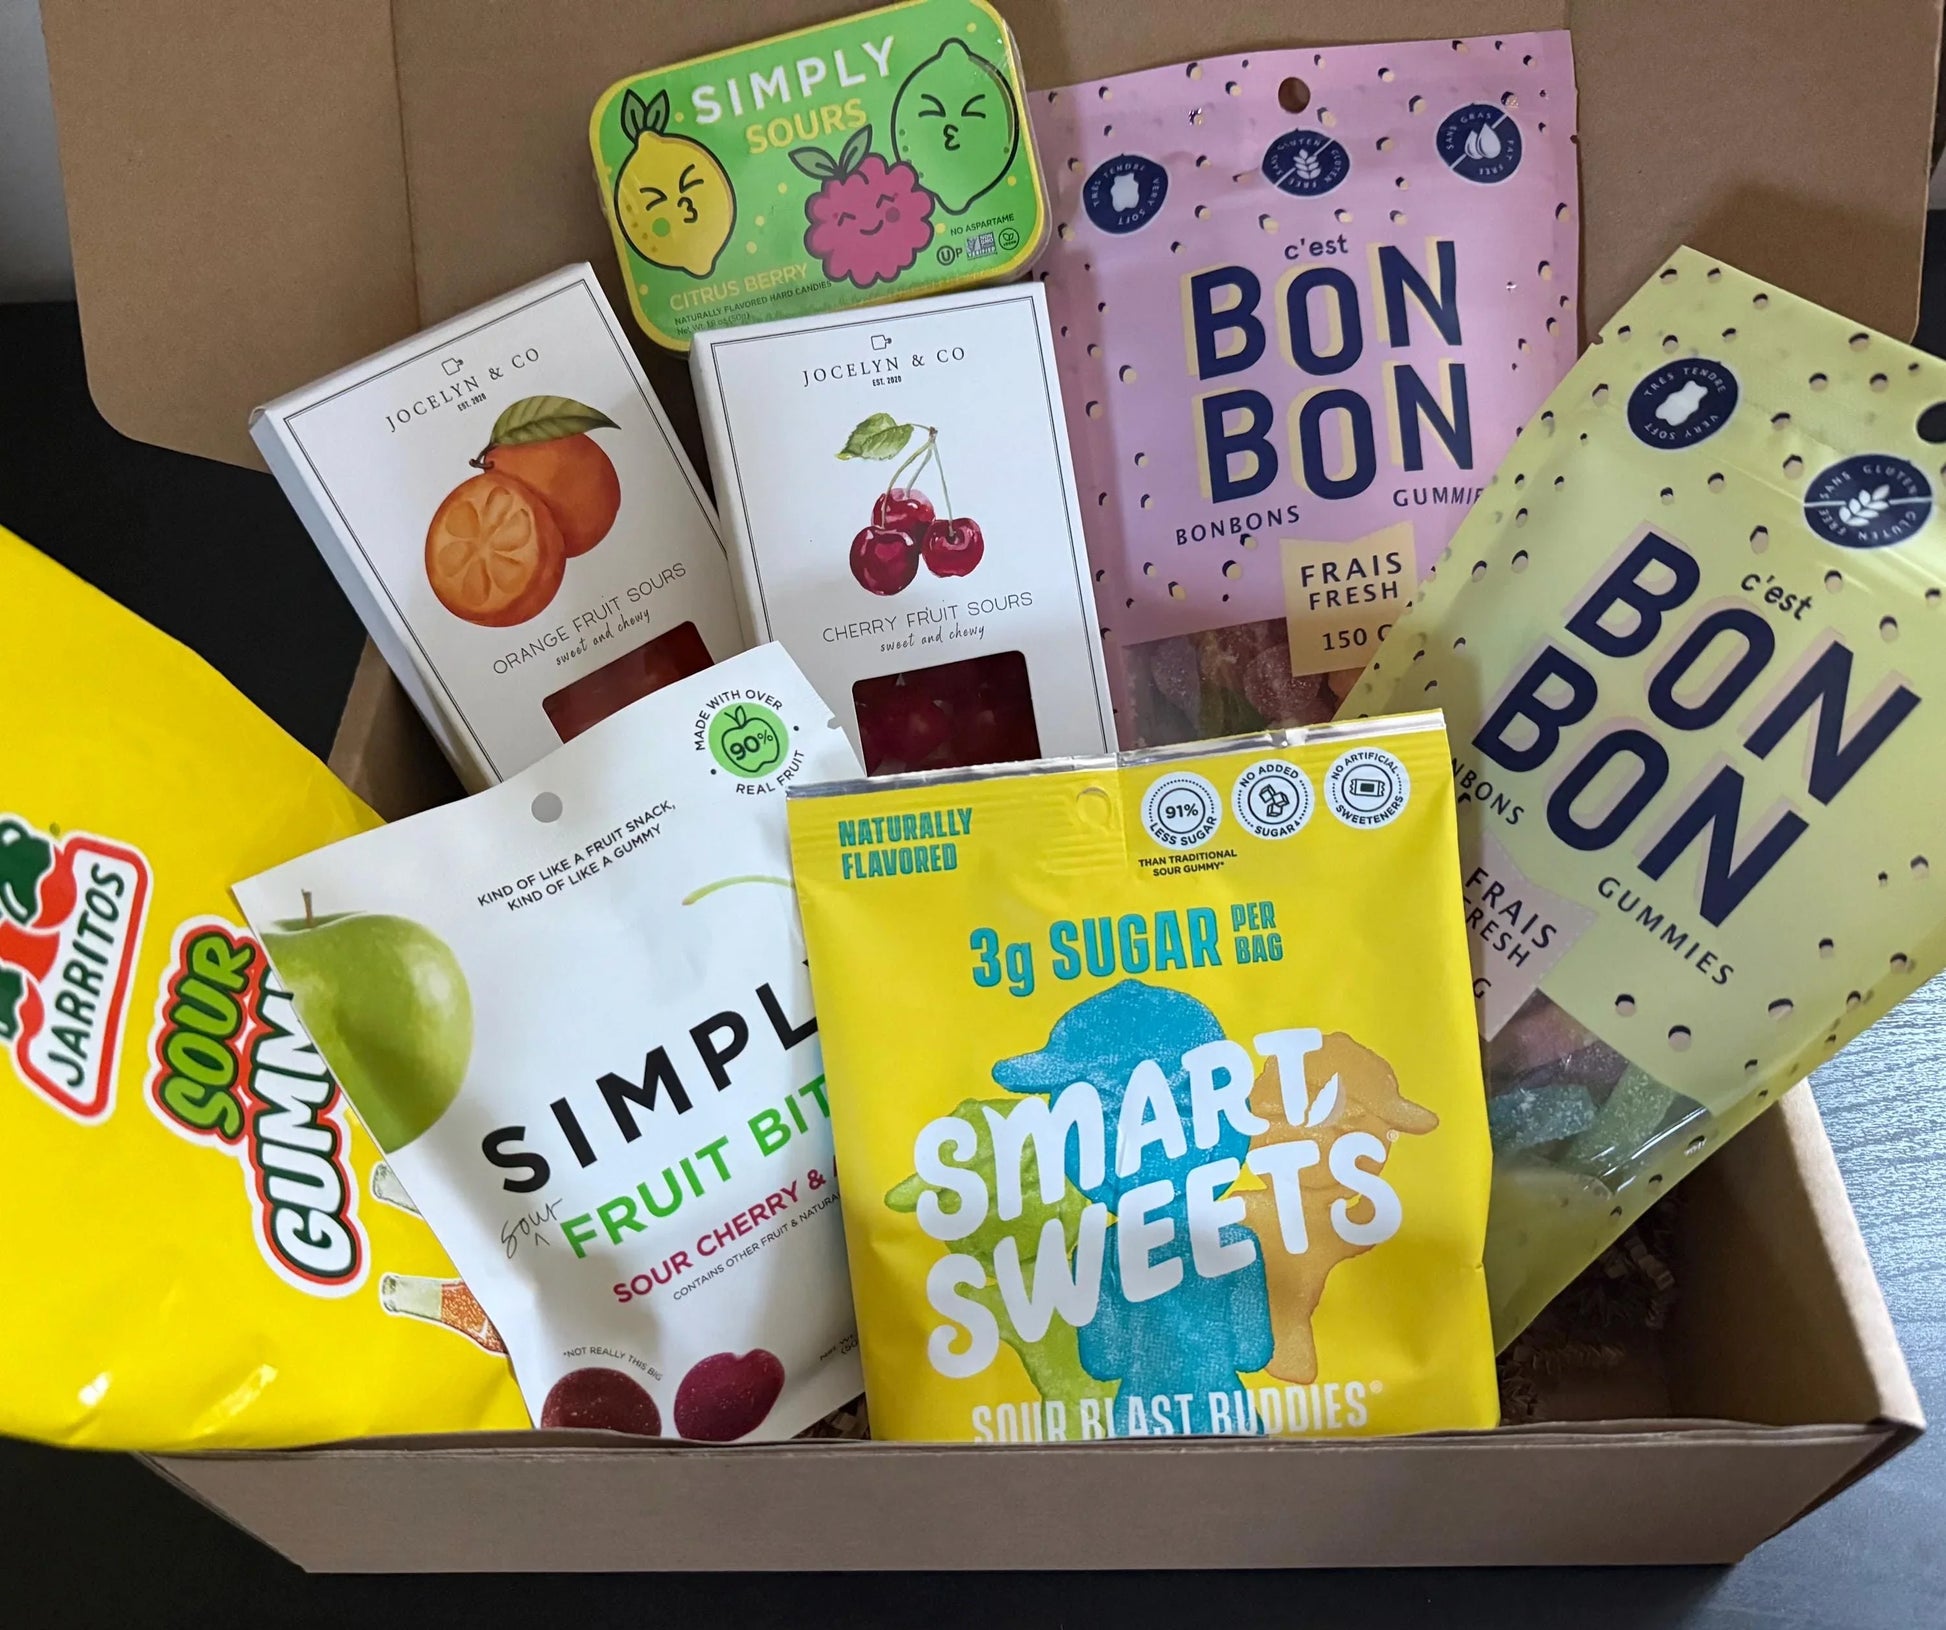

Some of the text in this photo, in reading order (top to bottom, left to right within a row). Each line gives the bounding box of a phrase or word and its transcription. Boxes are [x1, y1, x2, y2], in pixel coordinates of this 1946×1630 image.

[692, 35, 895, 124] SIMPLY
[744, 98, 868, 155] SOURS
[950, 213, 1015, 236] NO ASPARTAME
[1284, 233, 1349, 261] c'est
[670, 263, 808, 312] CITRUS BERRY
[674, 280, 832, 326] NATURALLY FLAVORED HARD CANDIES
[1186, 239, 1463, 381] BON
[386, 347, 540, 433] JOCELYN & CO
[802, 346, 966, 388] JOCELYN & CO
[872, 375, 902, 387] EST. 2020
[1683, 367, 1727, 393] TENDRE
[457, 392, 487, 412] EST. 2020
[1198, 361, 1474, 504] BON
[1644, 414, 1719, 440] VERY SOFT
[1176, 505, 1301, 546] BONBONS
[1300, 551, 1403, 588] FRAIS
[492, 562, 687, 675] ORANGE FRUIT SOURS
[822, 591, 1033, 643] CHERRY FRUIT SOURS
[1308, 580, 1399, 611] FRESH
[1740, 571, 1814, 621] c'est
[556, 608, 651, 667] sweet and chewy
[880, 622, 985, 652] sweet and chewy
[1322, 627, 1367, 651] 150
[1562, 528, 1923, 808] BON
[694, 689, 783, 751] MADE WITH OVER
[729, 729, 774, 761] 90%
[1331, 751, 1398, 780] NO ARTIFICIAL
[735, 749, 805, 795] REAL FRUIT
[1239, 763, 1299, 788] NO ADDED
[1470, 642, 1811, 929] BON
[837, 807, 973, 848] NATURALLY
[1149, 815, 1218, 846] LESS SUGAR
[1165, 803, 1199, 819] 91%
[1335, 794, 1404, 825] SWEETENERS
[477, 800, 677, 907] KIND OF LIKE A FRUIT SNACK,
[507, 823, 662, 912] KIND OF LIKE A GUMMY
[841, 842, 959, 881] FLAVORED
[1138, 849, 1238, 867] THAN TRADITIONAL
[1153, 866, 1182, 877] SOUR
[1230, 900, 1277, 933] PER
[1464, 867, 1558, 950] FRAIS
[1598, 876, 1735, 987] GUMMIES
[968, 906, 1223, 999] 3g SUGAR
[1234, 932, 1285, 965] BAG
[47, 862, 127, 1088] JARRITOS
[160, 932, 255, 1141] SOUR
[481, 959, 819, 1194] SIMPL
[247, 967, 357, 1273] GUMM
[913, 1027, 1325, 1242] SMART
[559, 1135, 733, 1260] FRUIT
[612, 1168, 827, 1304] SOUR CHERRY &
[673, 1264, 725, 1301] CONTAINS
[725, 1242, 761, 1268] OTHER
[761, 1223, 789, 1247] FRUIT
[790, 1219, 799, 1229] &
[926, 1130, 1403, 1379] SWEETS
[589, 1346, 626, 1359] REALLY
[628, 1354, 648, 1371] THIS
[647, 1366, 664, 1382] BIG
[971, 1399, 1068, 1443] SOUR
[1080, 1393, 1195, 1441] BLAST
